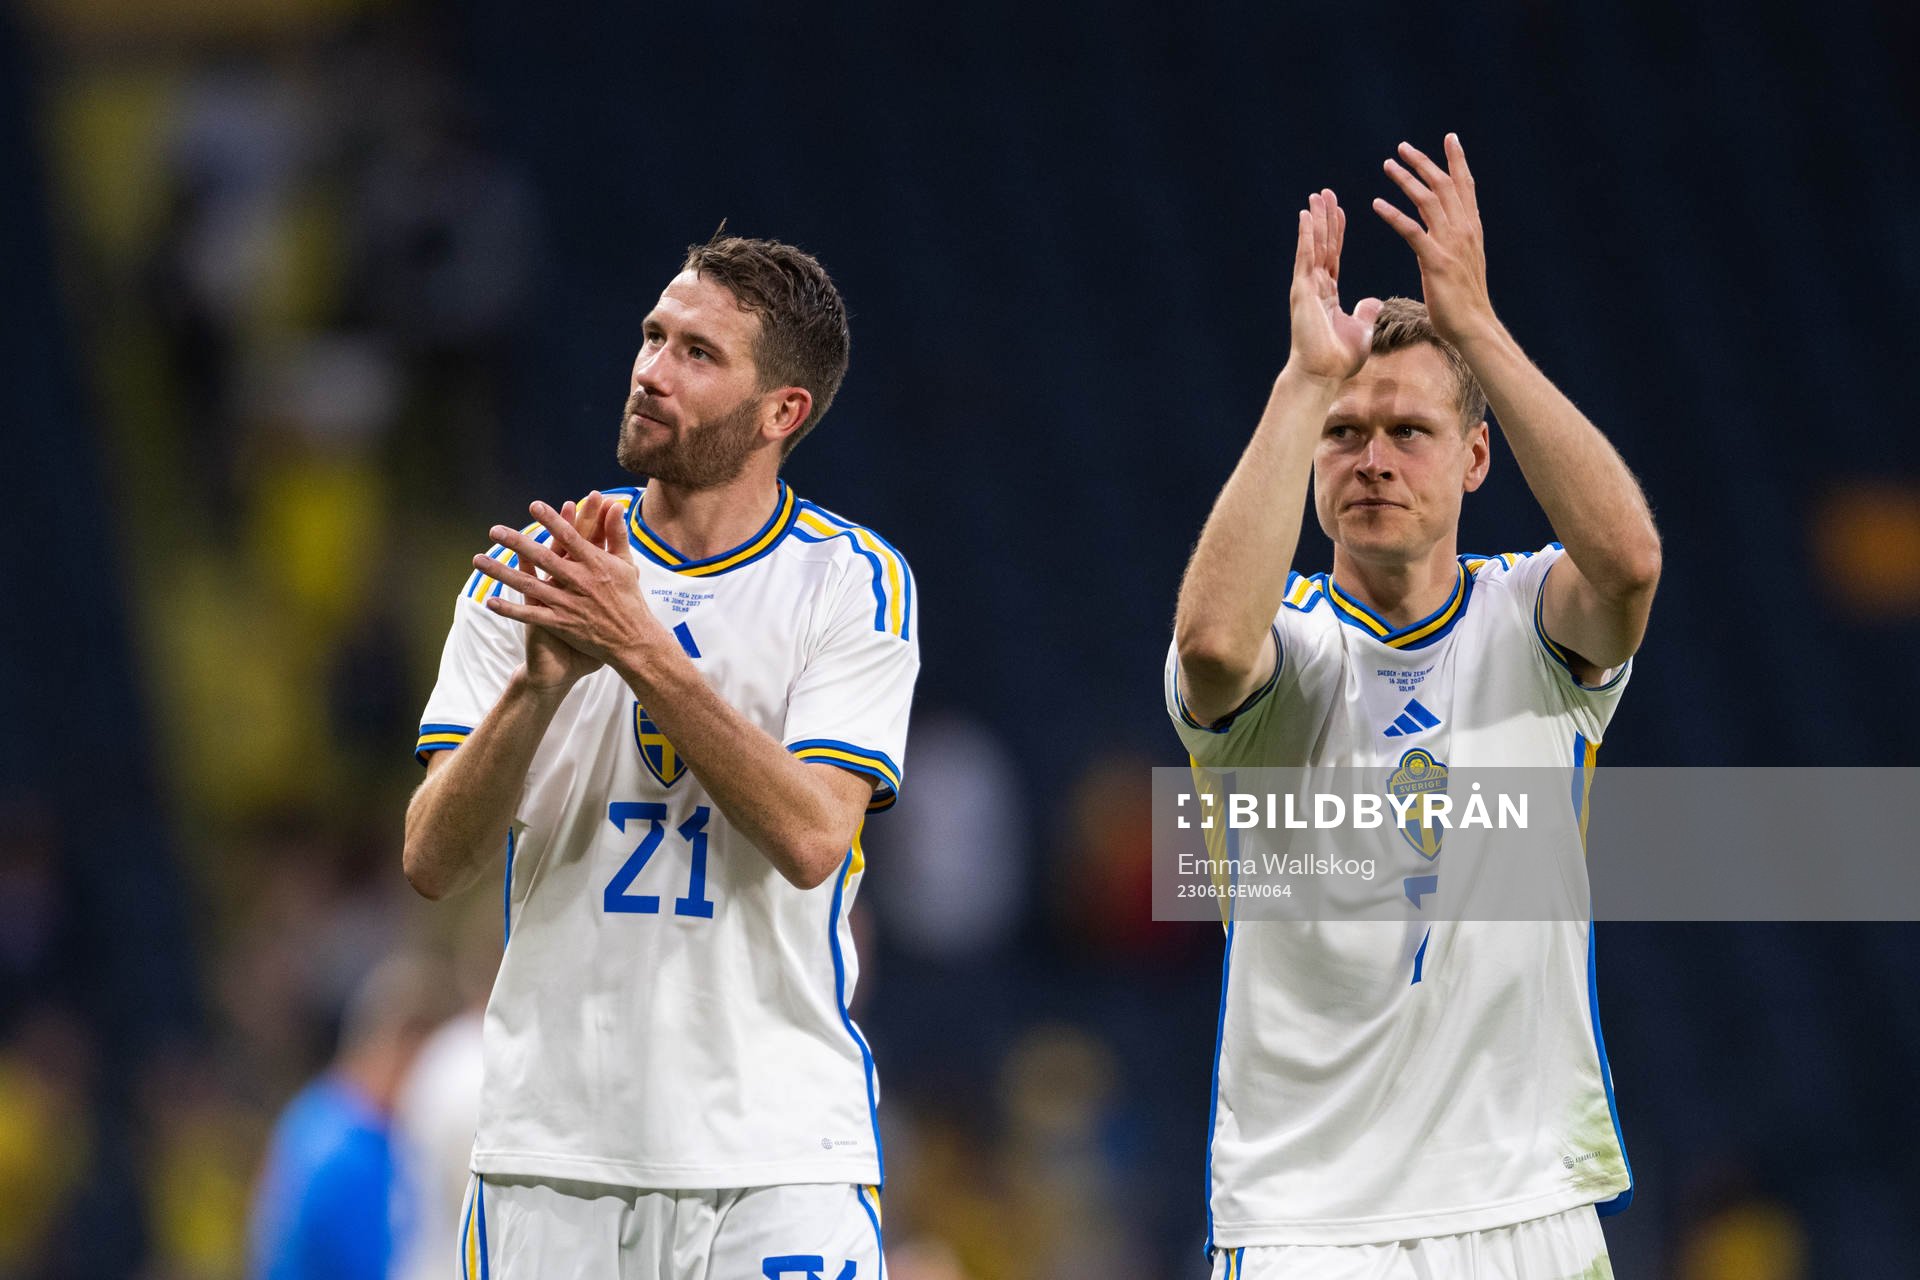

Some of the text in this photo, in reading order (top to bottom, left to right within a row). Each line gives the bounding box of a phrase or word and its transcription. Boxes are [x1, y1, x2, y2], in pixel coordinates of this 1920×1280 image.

[679, 591, 689, 599] NEW
[671, 598, 685, 606] JUNE
[1377, 669, 1397, 677] SWEDEN
[1399, 780, 1442, 793] SVERIGE
[604, 801, 714, 919] 21
